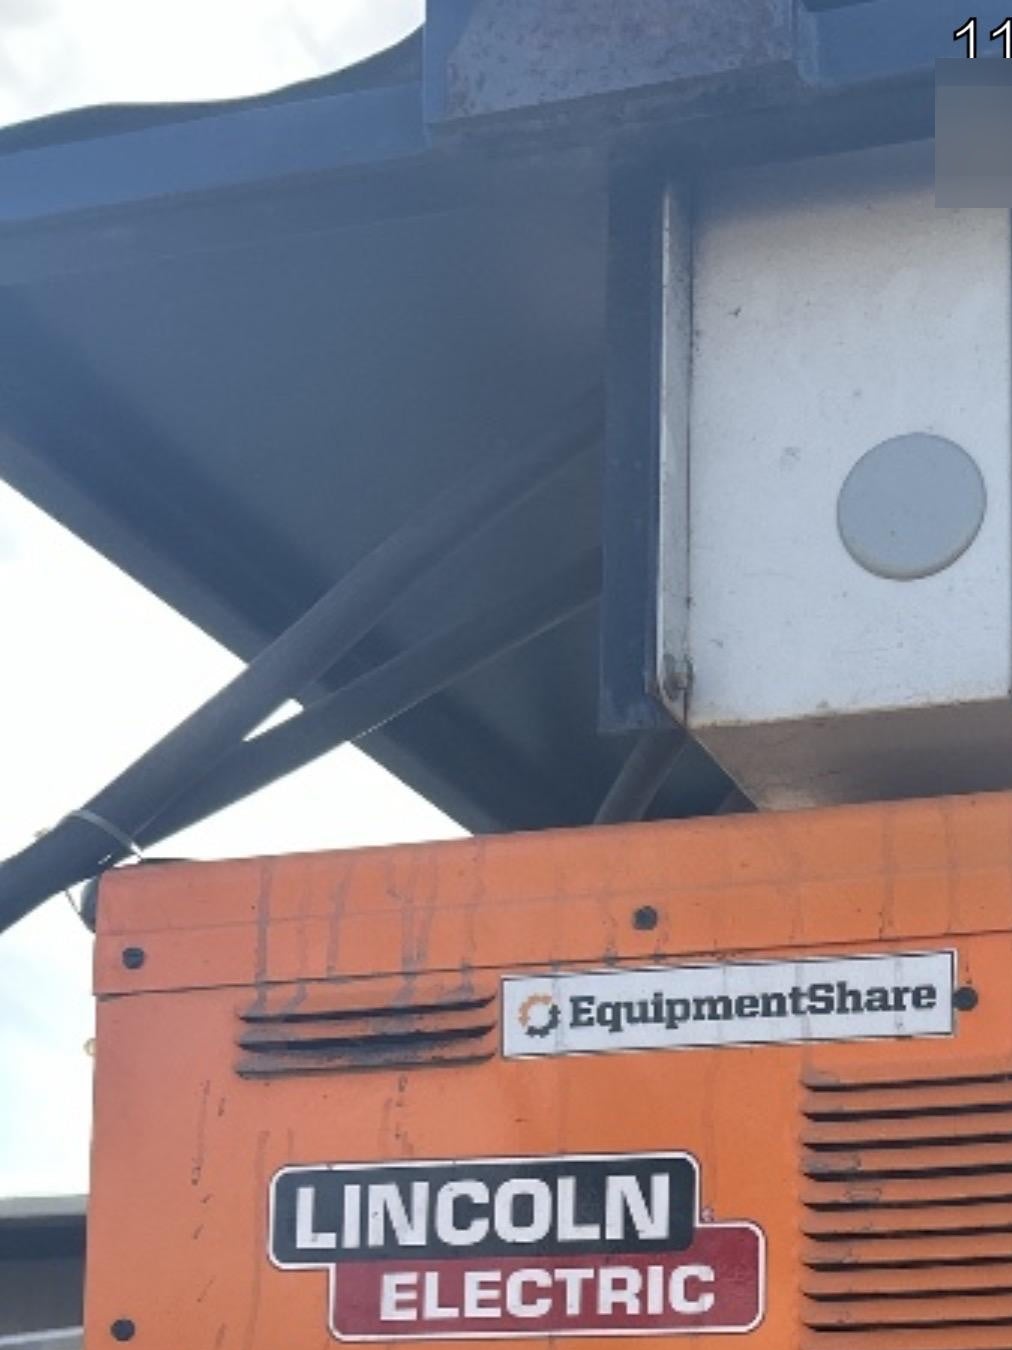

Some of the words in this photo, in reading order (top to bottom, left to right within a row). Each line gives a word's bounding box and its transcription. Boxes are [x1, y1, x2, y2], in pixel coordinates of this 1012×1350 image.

[569, 982, 937, 1033] EquipmentShare
[296, 1173, 670, 1249] LINCOLN
[380, 1264, 716, 1321] ELECTRIC
